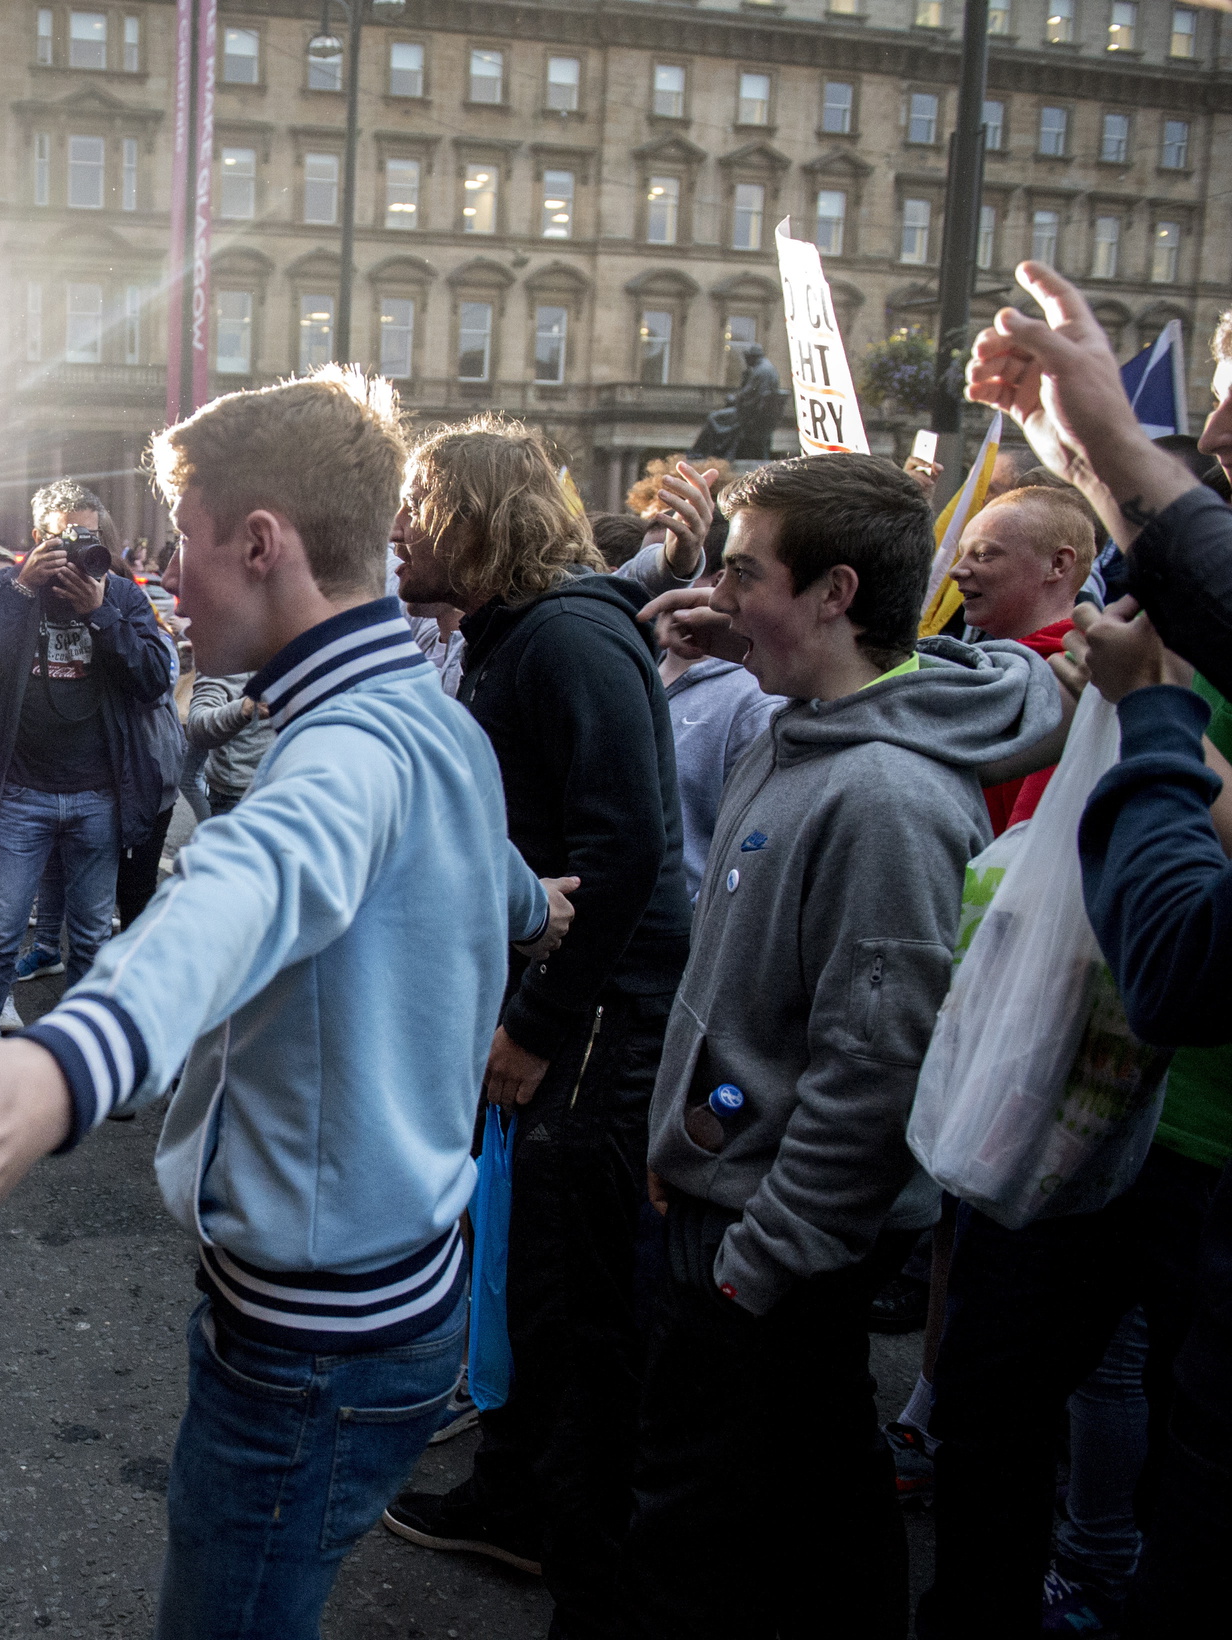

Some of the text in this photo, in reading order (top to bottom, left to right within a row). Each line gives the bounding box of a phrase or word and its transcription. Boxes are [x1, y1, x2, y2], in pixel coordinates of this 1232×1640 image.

[201, 55, 216, 161] MAKE
[191, 167, 211, 351] GLASGOW
[794, 339, 831, 387] HT
